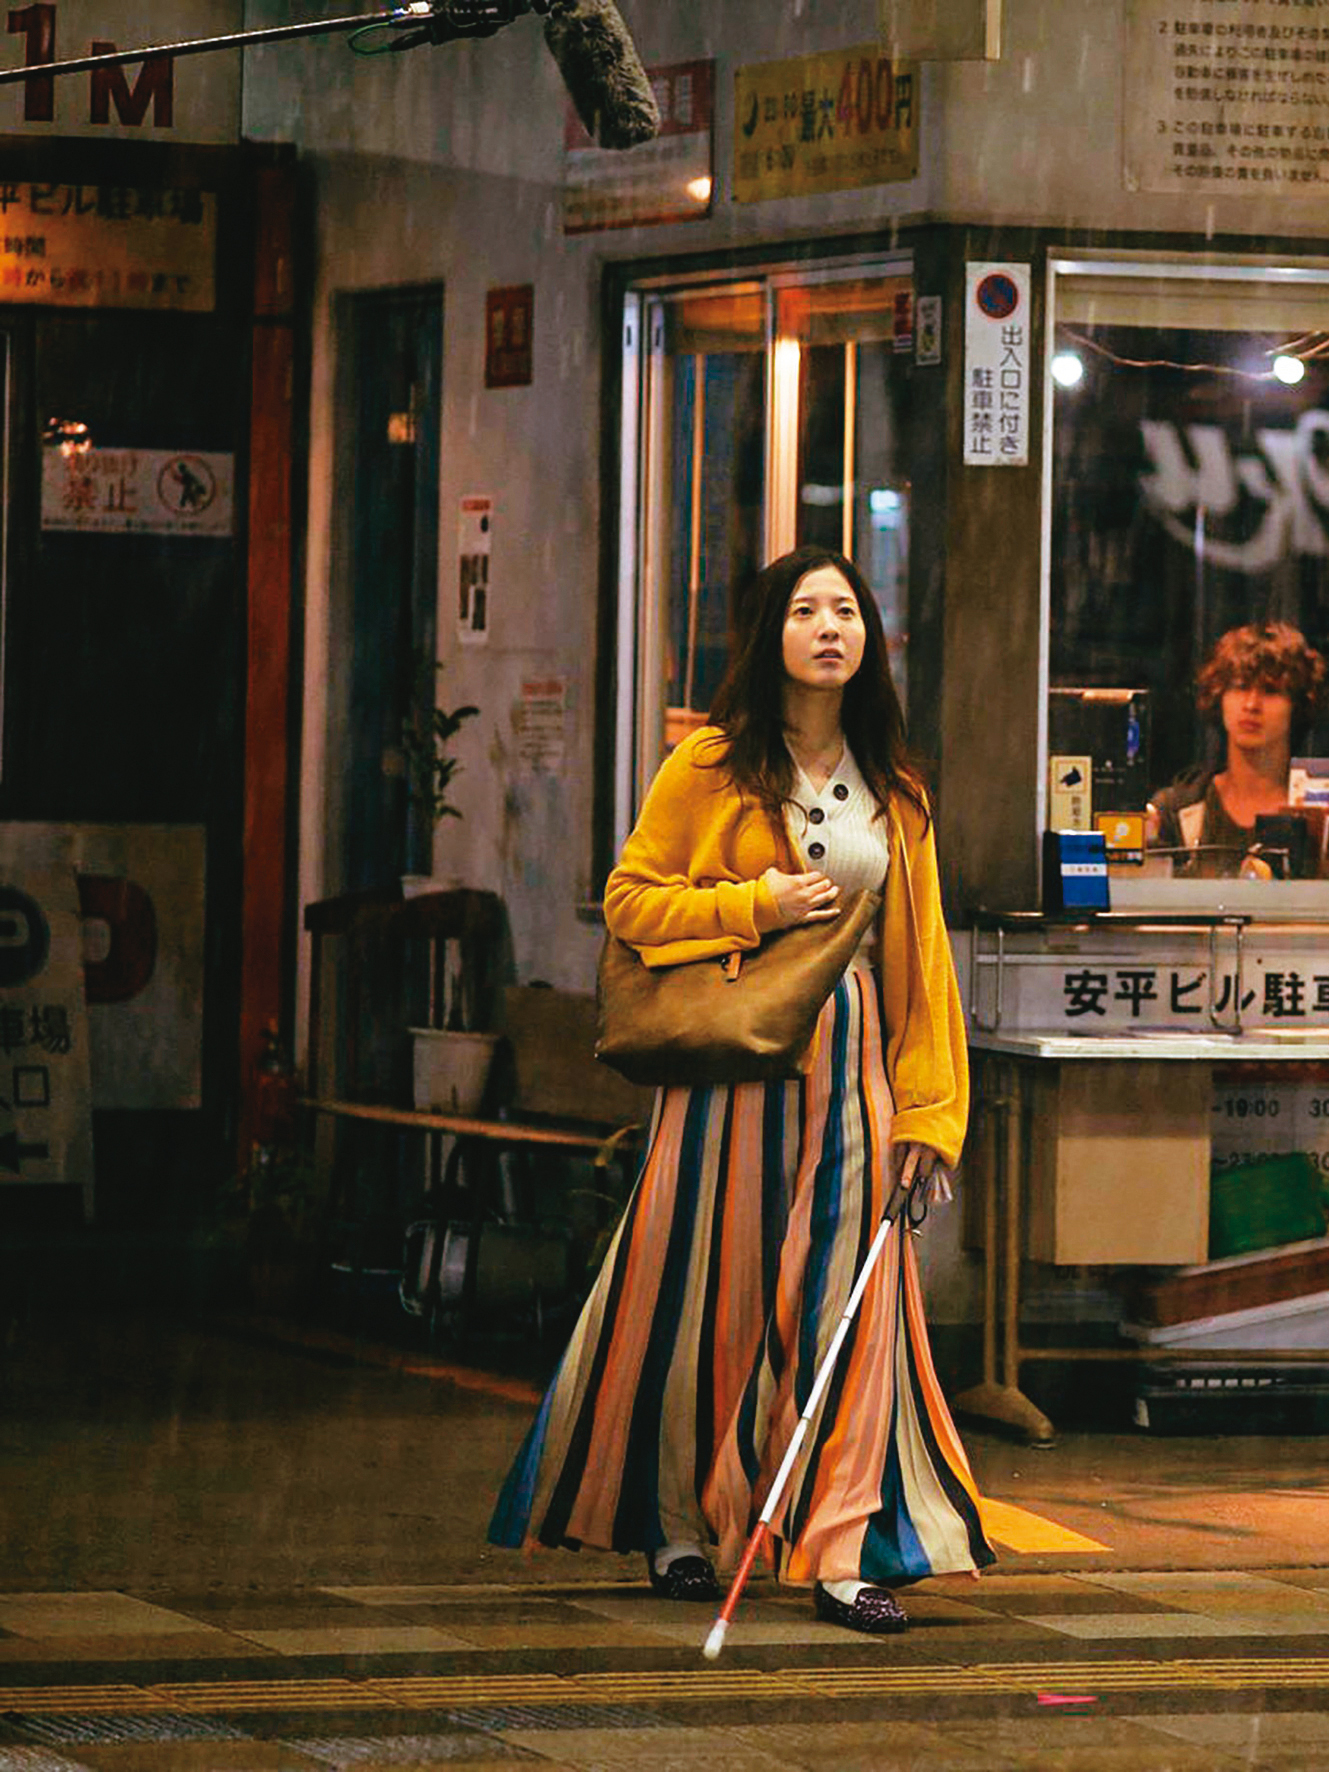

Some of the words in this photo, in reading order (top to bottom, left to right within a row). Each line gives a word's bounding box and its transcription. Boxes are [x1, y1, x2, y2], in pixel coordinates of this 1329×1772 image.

[970, 367, 993, 455] 駐車禁止
[1000, 326, 1023, 455] 出入口に付き
